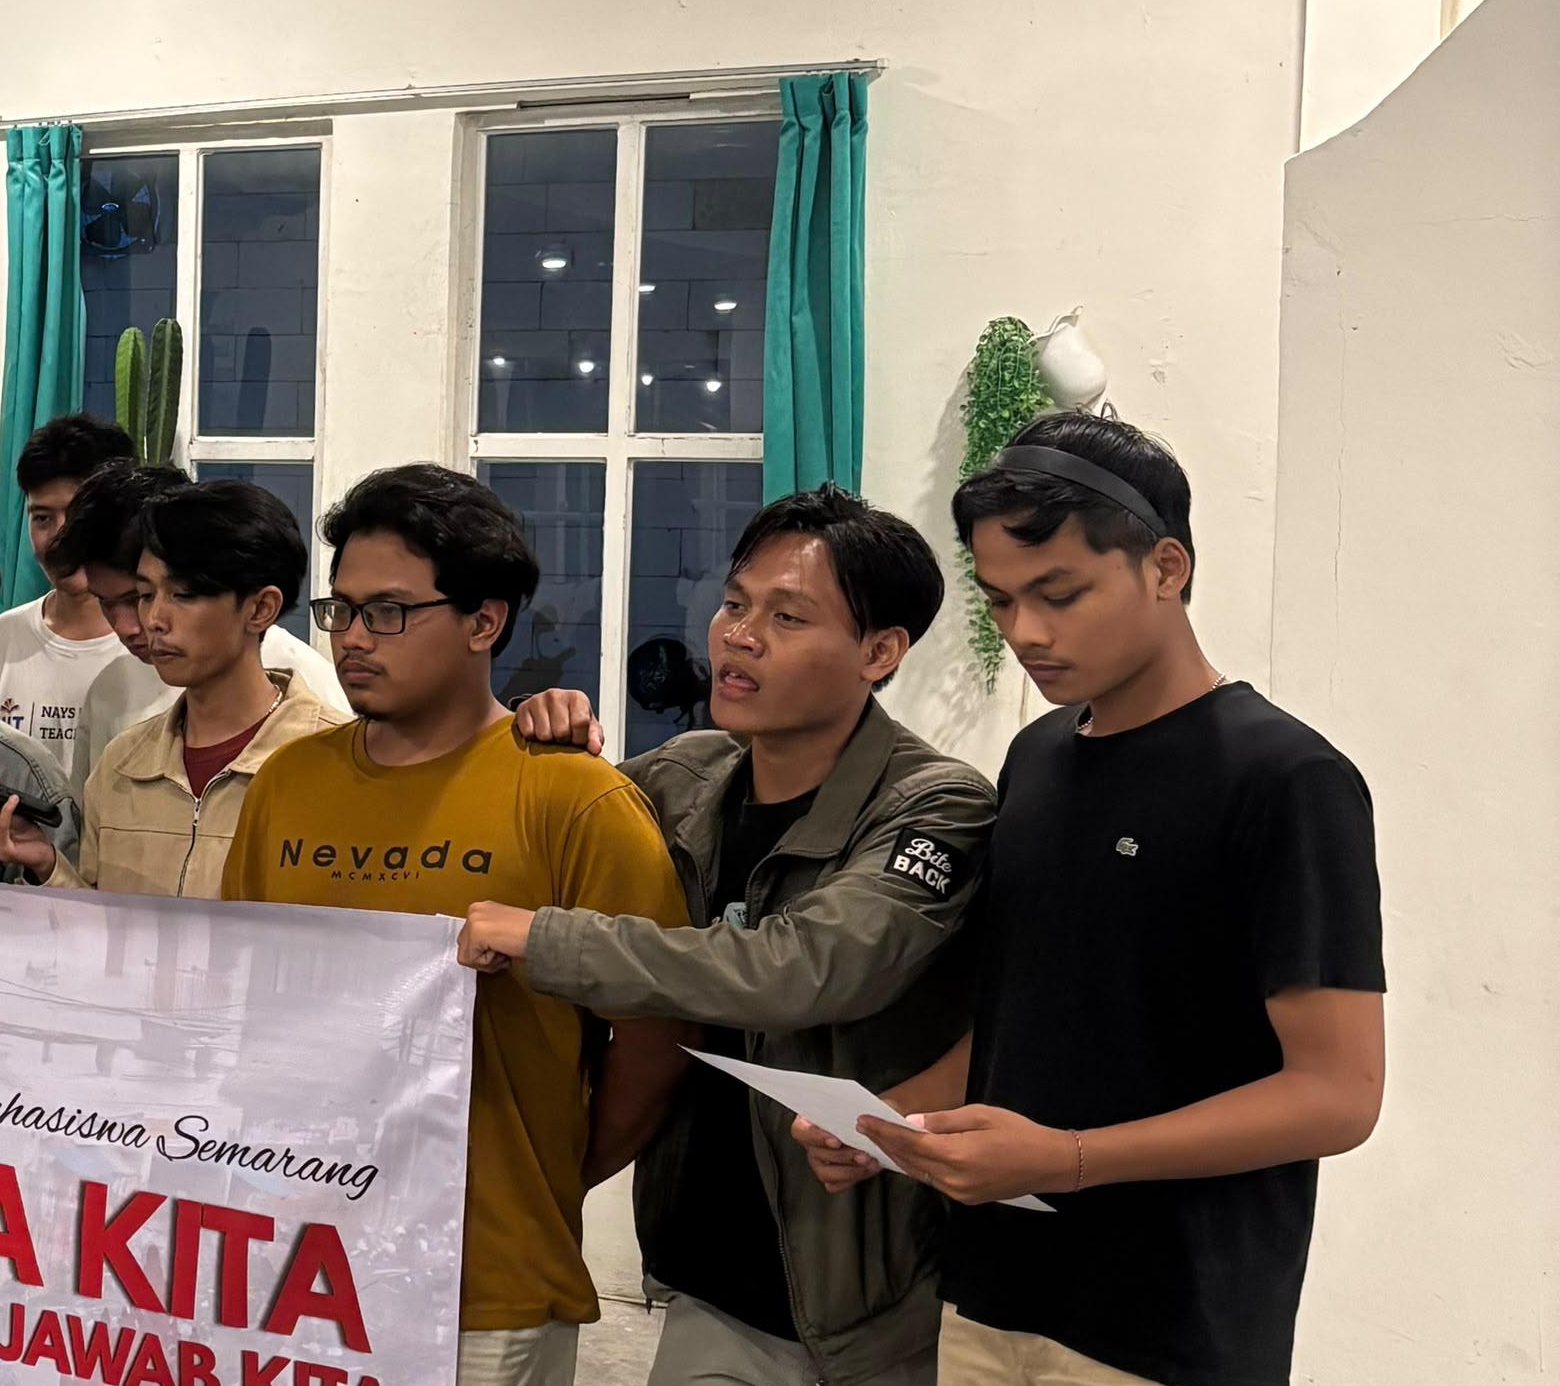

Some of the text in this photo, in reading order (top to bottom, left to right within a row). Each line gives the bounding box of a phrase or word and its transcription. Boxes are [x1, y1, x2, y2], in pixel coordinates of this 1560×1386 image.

[40, 705, 76, 720] NAYS
[280, 838, 493, 875] Nevada
[893, 854, 951, 894] BACK
[905, 838, 952, 873] Bite
[156, 1115, 380, 1200] Semarang
[77, 1181, 373, 1354] KITA
